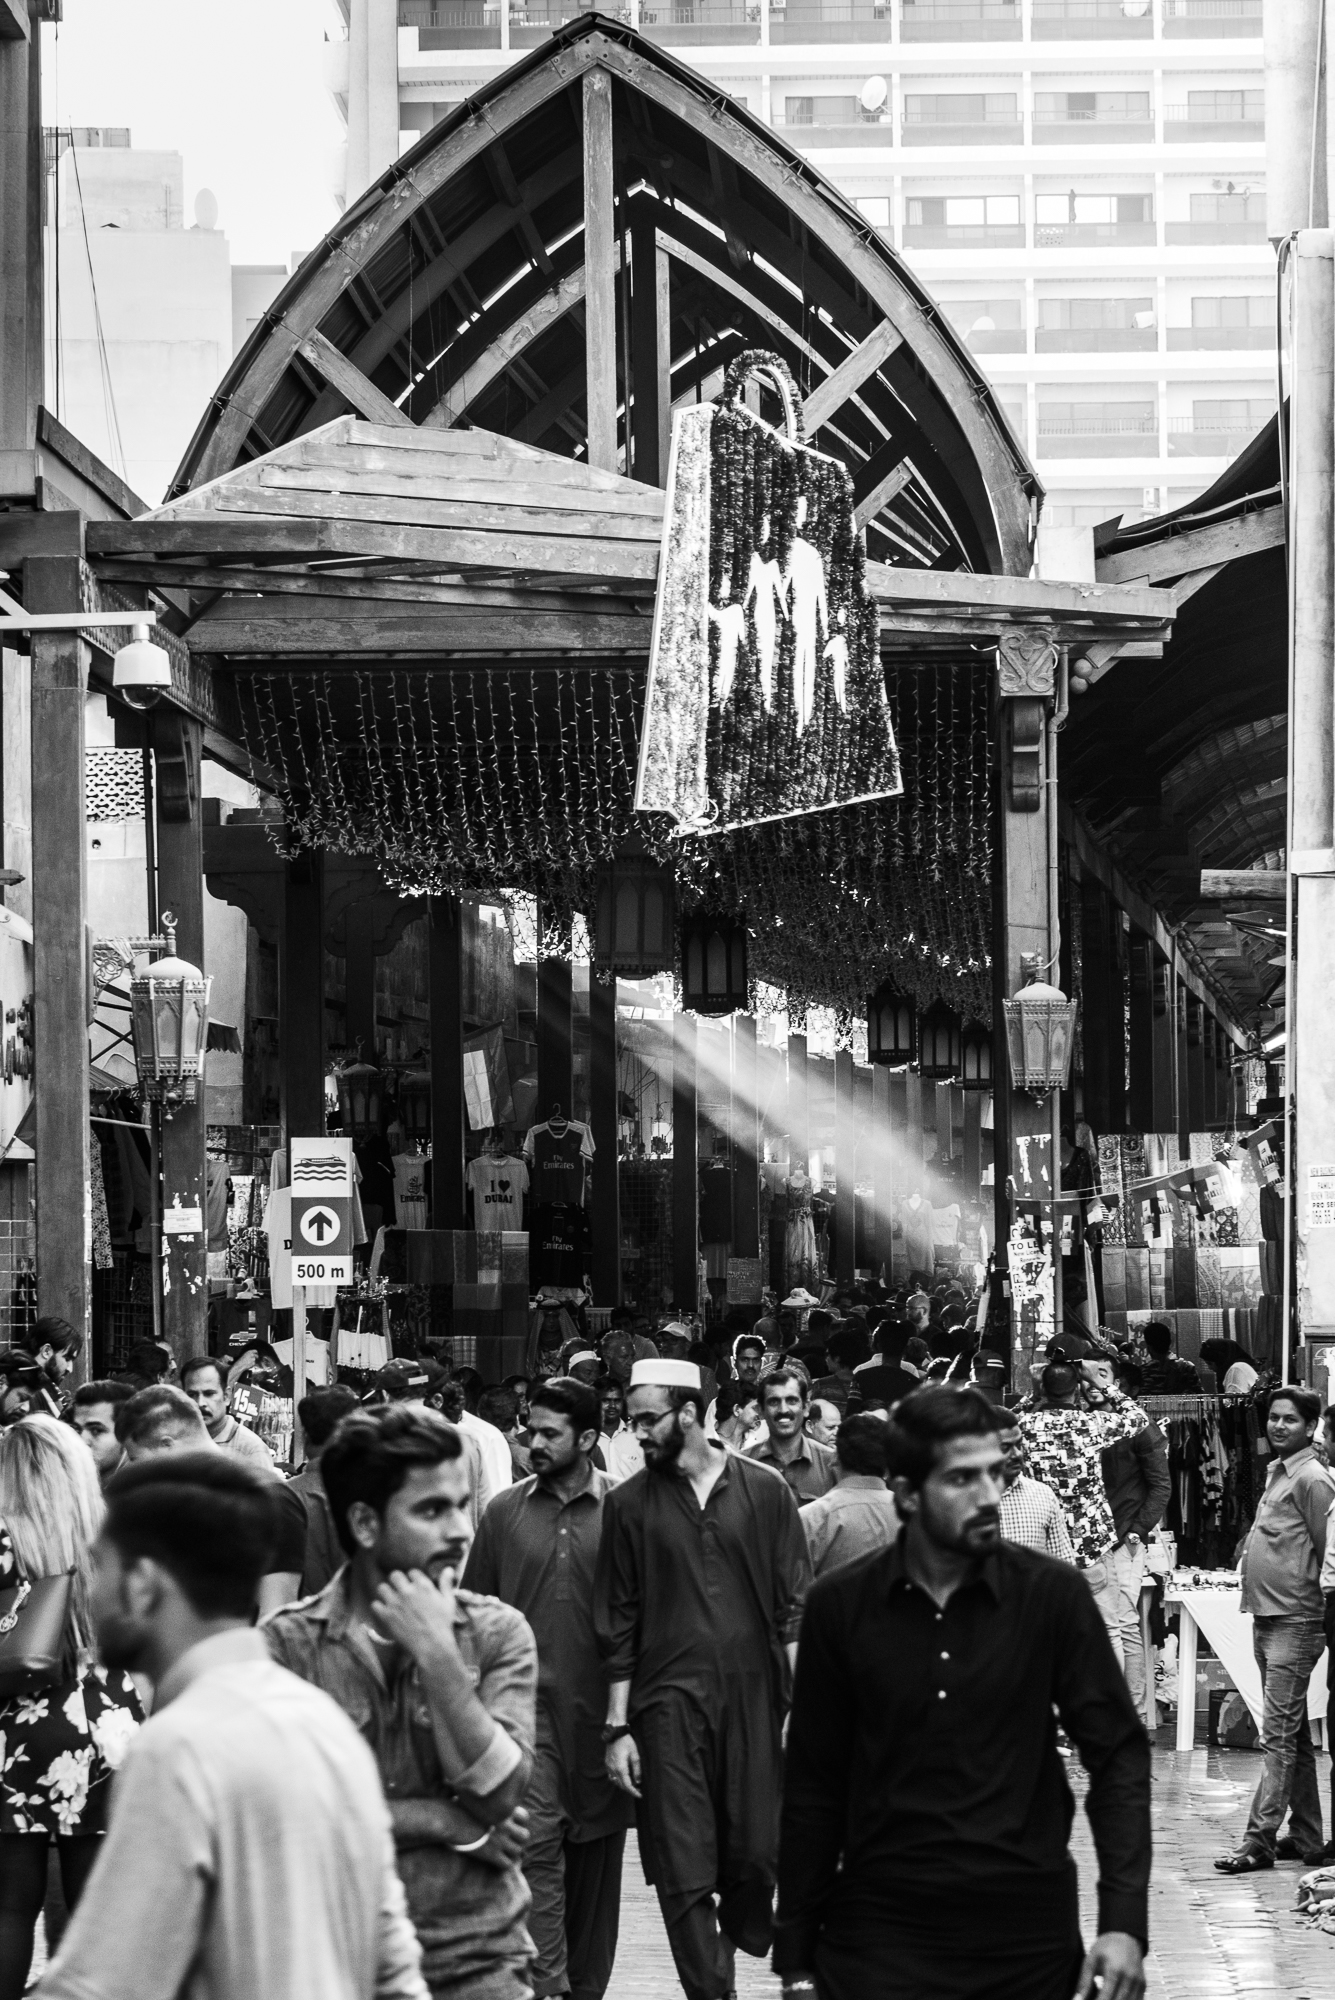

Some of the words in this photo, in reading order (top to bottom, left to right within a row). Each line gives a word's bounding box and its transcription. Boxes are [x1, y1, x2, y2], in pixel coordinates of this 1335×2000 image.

[543, 1161, 574, 1170] Emirates
[490, 1180, 495, 1192] I
[484, 1194, 513, 1204] DUBAI
[542, 1241, 574, 1251] Emirates
[1027, 1241, 1039, 1249] LE
[297, 1264, 325, 1278] 500
[331, 1267, 344, 1278] m
[234, 1387, 250, 1412] 15
